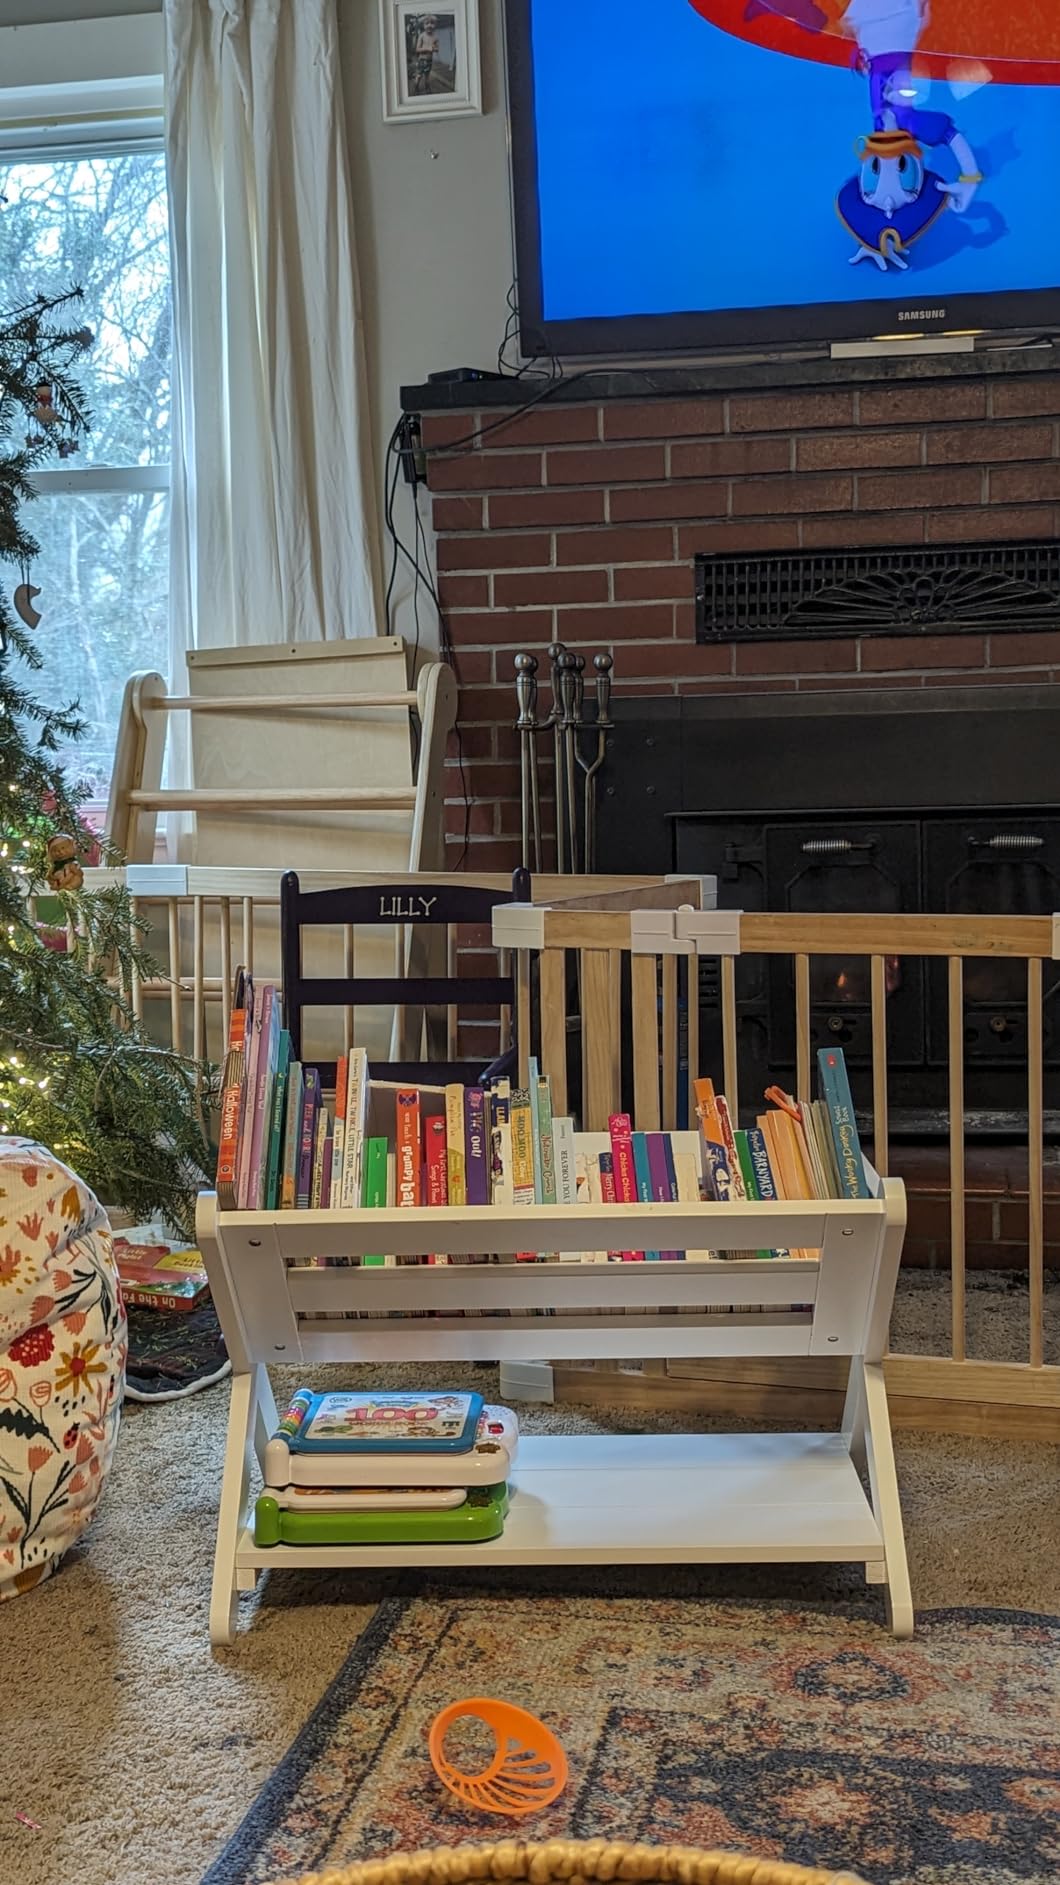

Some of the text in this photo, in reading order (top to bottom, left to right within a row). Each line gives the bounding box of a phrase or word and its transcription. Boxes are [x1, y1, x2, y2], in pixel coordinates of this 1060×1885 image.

[898, 309, 946, 321] SAMSUNG
[380, 896, 438, 917] LILLY
[224, 1089, 240, 1140] Halloween
[838, 1124, 854, 1157] Donkey
[346, 1153, 354, 1169] STAR
[541, 1134, 552, 1169] Nutcracker
[401, 1145, 414, 1181] grumpy
[429, 1164, 440, 1181] Songs
[560, 1149, 570, 1182] FOREVER
[752, 1150, 774, 1197] BARNYARD
[843, 1158, 858, 1185] Wonky
[562, 1183, 571, 1200] YOU
[604, 1173, 613, 1190] Merry
[400, 1182, 416, 1207] bat
[138, 1293, 158, 1306] the
[162, 1296, 176, 1309] On
[344, 1407, 439, 1422] 100
